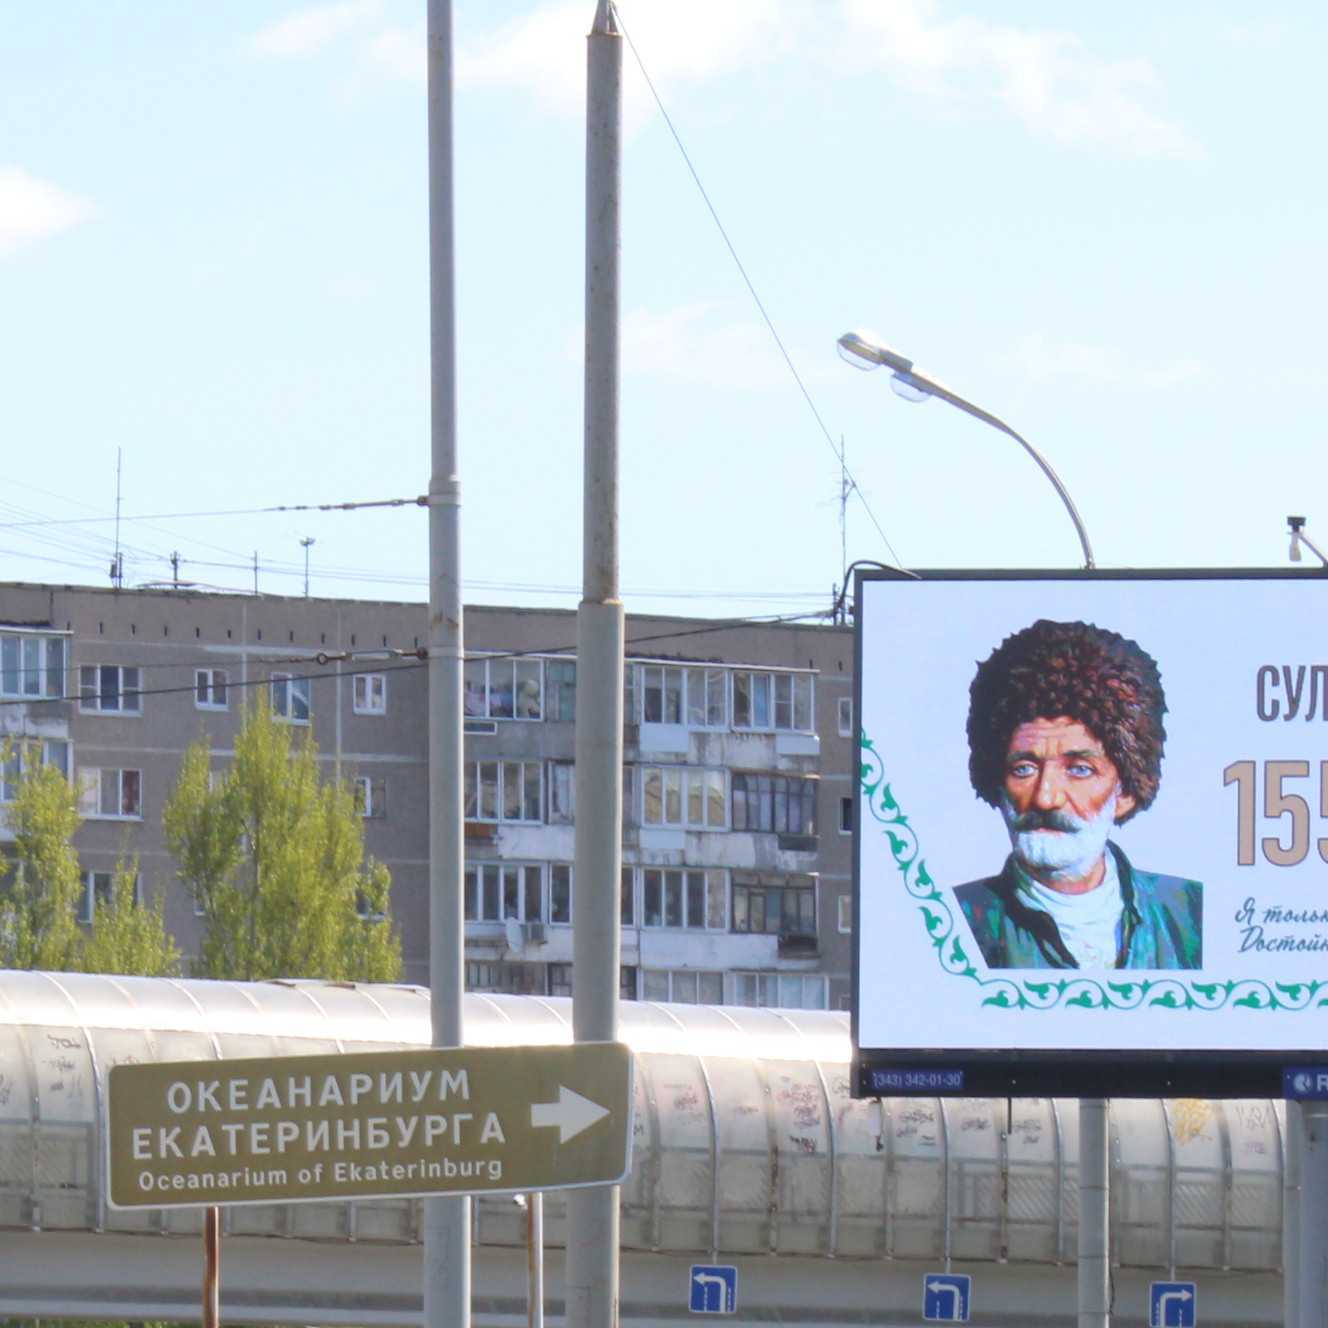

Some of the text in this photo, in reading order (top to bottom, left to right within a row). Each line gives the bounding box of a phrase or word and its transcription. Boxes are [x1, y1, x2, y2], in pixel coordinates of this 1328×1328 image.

[1234, 897, 1256, 925] Я
[167, 1068, 470, 1114] ОКЕАНАРИУМ
[904, 1072, 962, 1087] 342-01-30
[132, 1111, 506, 1160] ЕКАТЕРИНБУРГА
[138, 1157, 503, 1191] Oceanarium of Ekaterinburg
